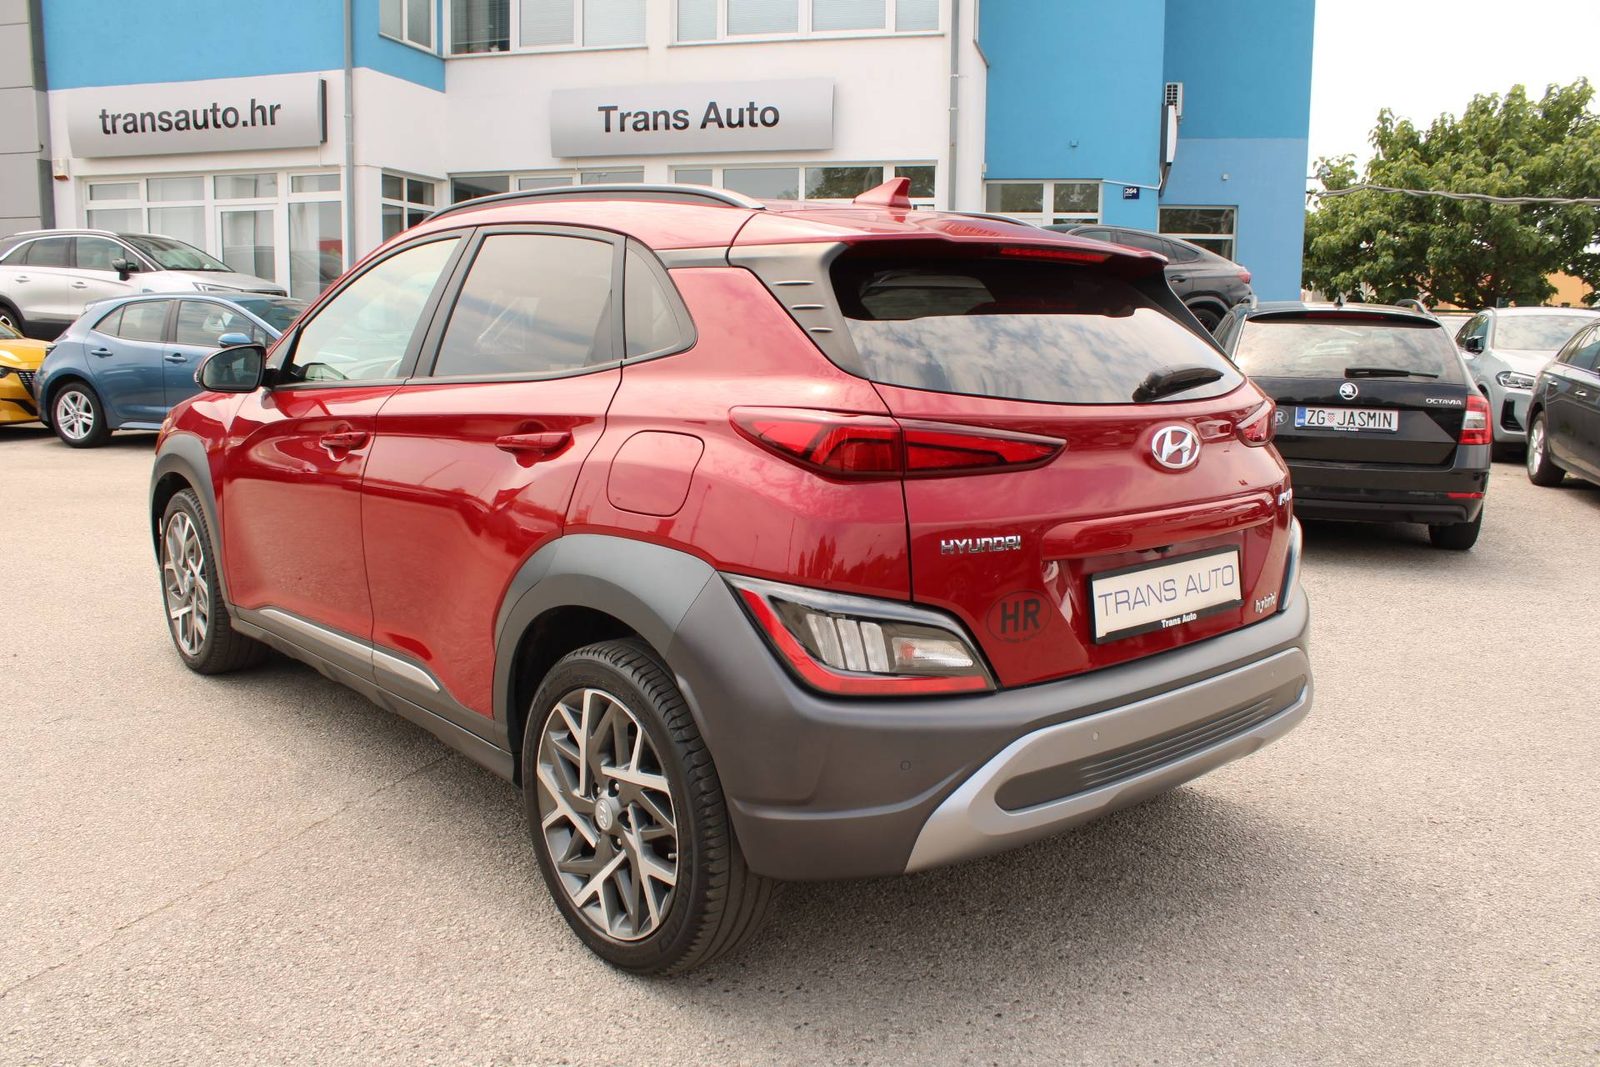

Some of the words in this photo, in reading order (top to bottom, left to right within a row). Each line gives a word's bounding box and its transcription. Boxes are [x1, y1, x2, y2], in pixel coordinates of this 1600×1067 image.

[99, 98, 282, 135] transauto.hr
[598, 105, 690, 133] Trans
[700, 101, 780, 130] Auto
[1425, 397, 1462, 405] OCTAVIA
[1307, 409, 1326, 425] ZG
[1337, 411, 1393, 428] JASMIN
[941, 535, 1021, 555] HYUNDAI
[1098, 578, 1178, 617] TRANS
[1184, 564, 1235, 597] AUTO
[1000, 598, 1041, 634] HR
[1161, 617, 1181, 628] Trans
[1182, 612, 1198, 624] Auto
